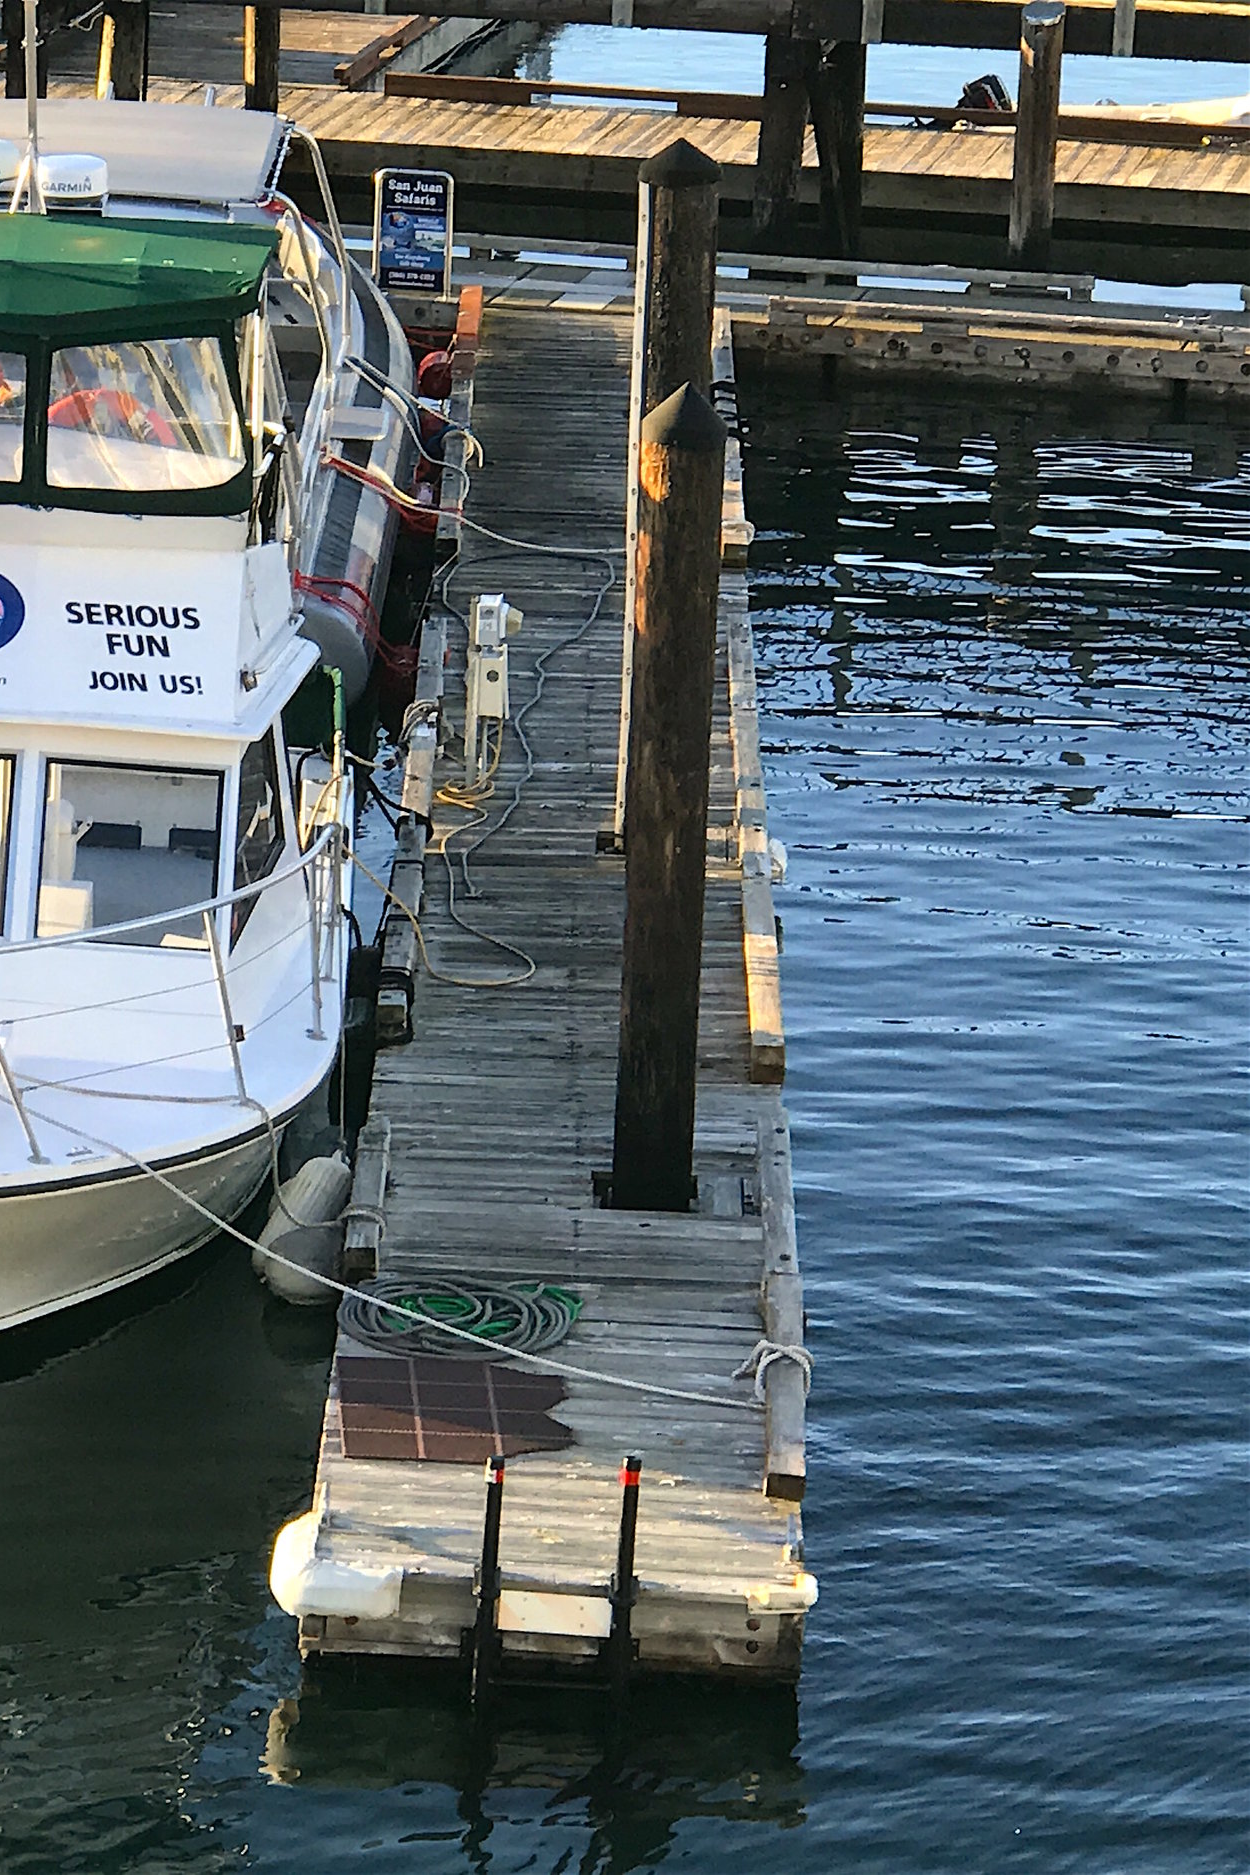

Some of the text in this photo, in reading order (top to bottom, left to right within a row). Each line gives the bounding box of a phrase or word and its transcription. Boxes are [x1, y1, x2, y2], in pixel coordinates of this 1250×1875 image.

[42, 182, 92, 192] GARMIN
[388, 179, 443, 193] San Juan
[394, 192, 436, 206] Safaris
[65, 601, 201, 630] SERIOUS
[105, 633, 171, 657] FUN
[89, 670, 204, 695] JOIN US!
